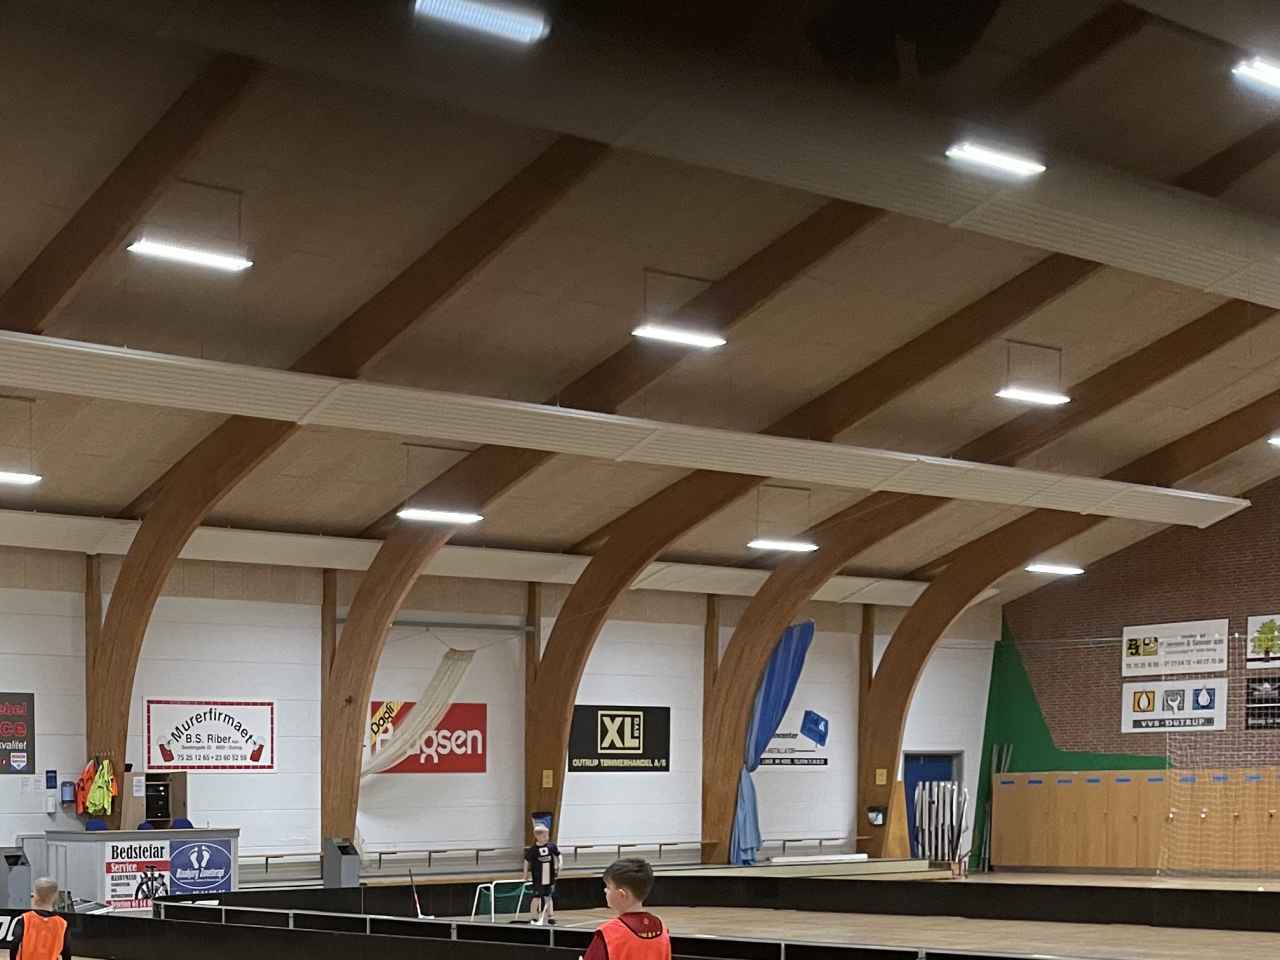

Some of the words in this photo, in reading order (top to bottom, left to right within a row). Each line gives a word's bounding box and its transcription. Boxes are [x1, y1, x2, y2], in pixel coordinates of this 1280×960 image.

[171, 708, 255, 744] Murerfirmaet
[601, 716, 639, 748] XL
[207, 734, 232, 744] Riber
[111, 845, 166, 860] Bedstefar
[111, 863, 138, 873] Service
